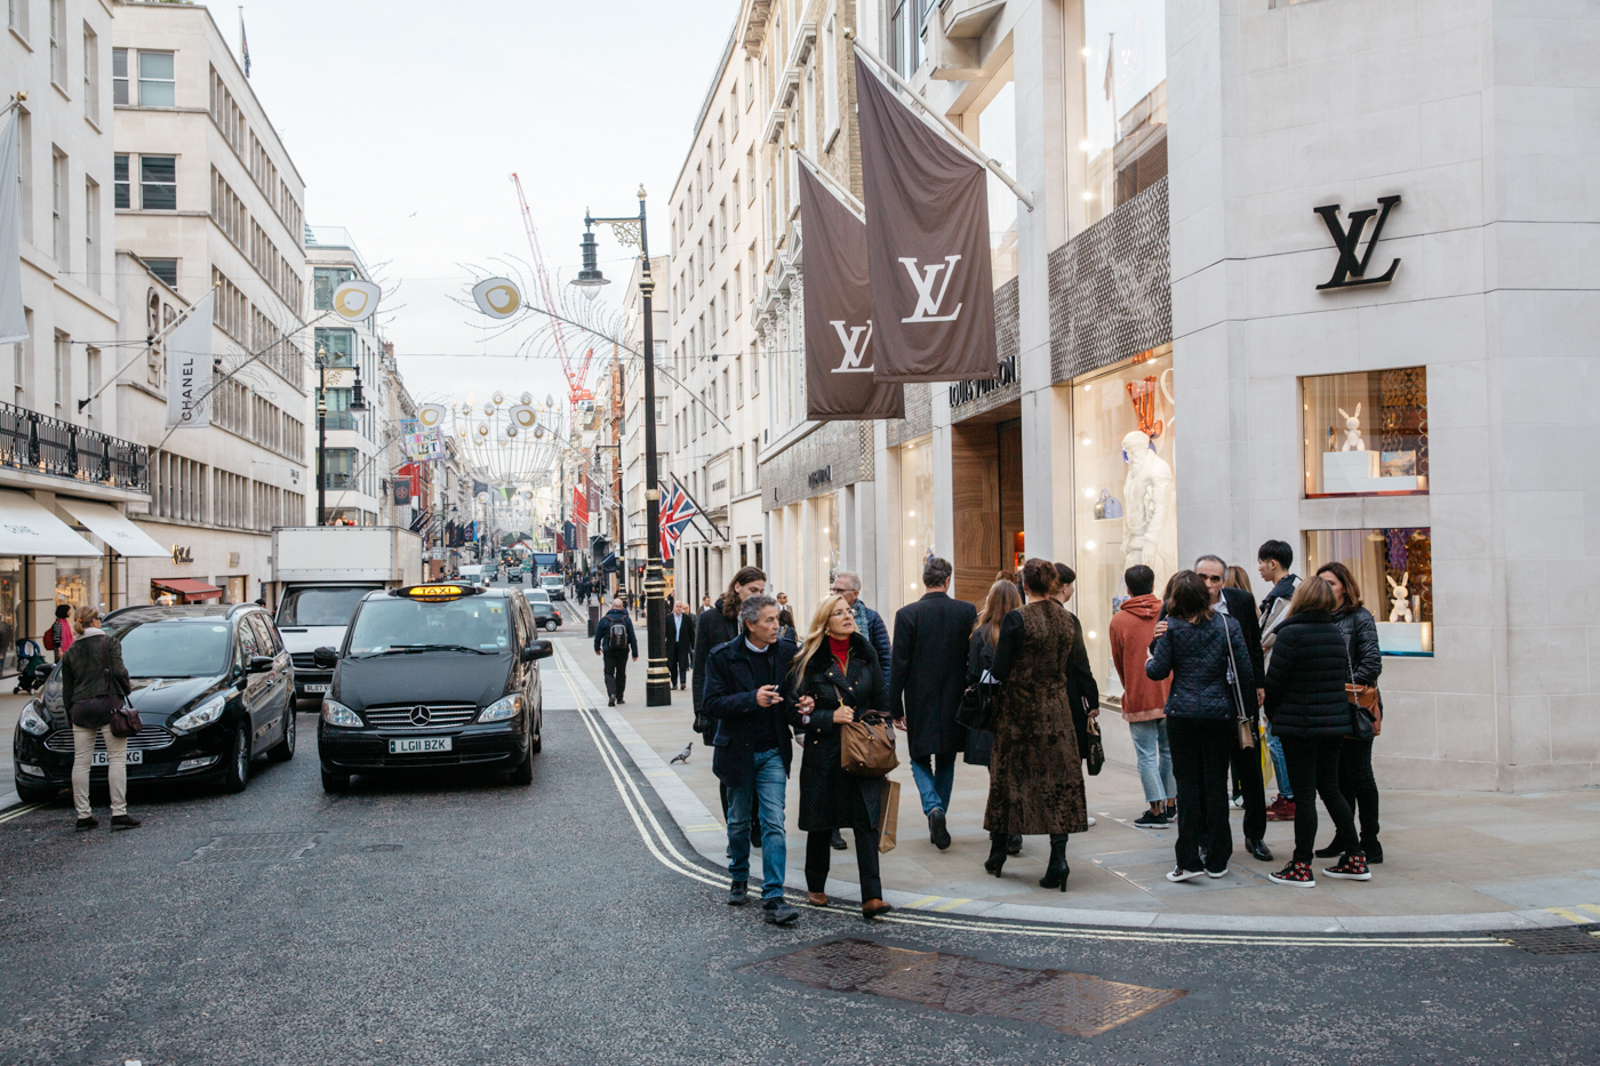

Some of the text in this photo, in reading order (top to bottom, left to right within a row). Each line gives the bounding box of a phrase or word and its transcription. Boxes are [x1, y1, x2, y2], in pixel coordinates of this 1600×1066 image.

[1313, 195, 1402, 290] LV
[898, 254, 963, 323] LV
[181, 358, 193, 421] CHANEL
[401, 739, 446, 751] LG11 BZK
